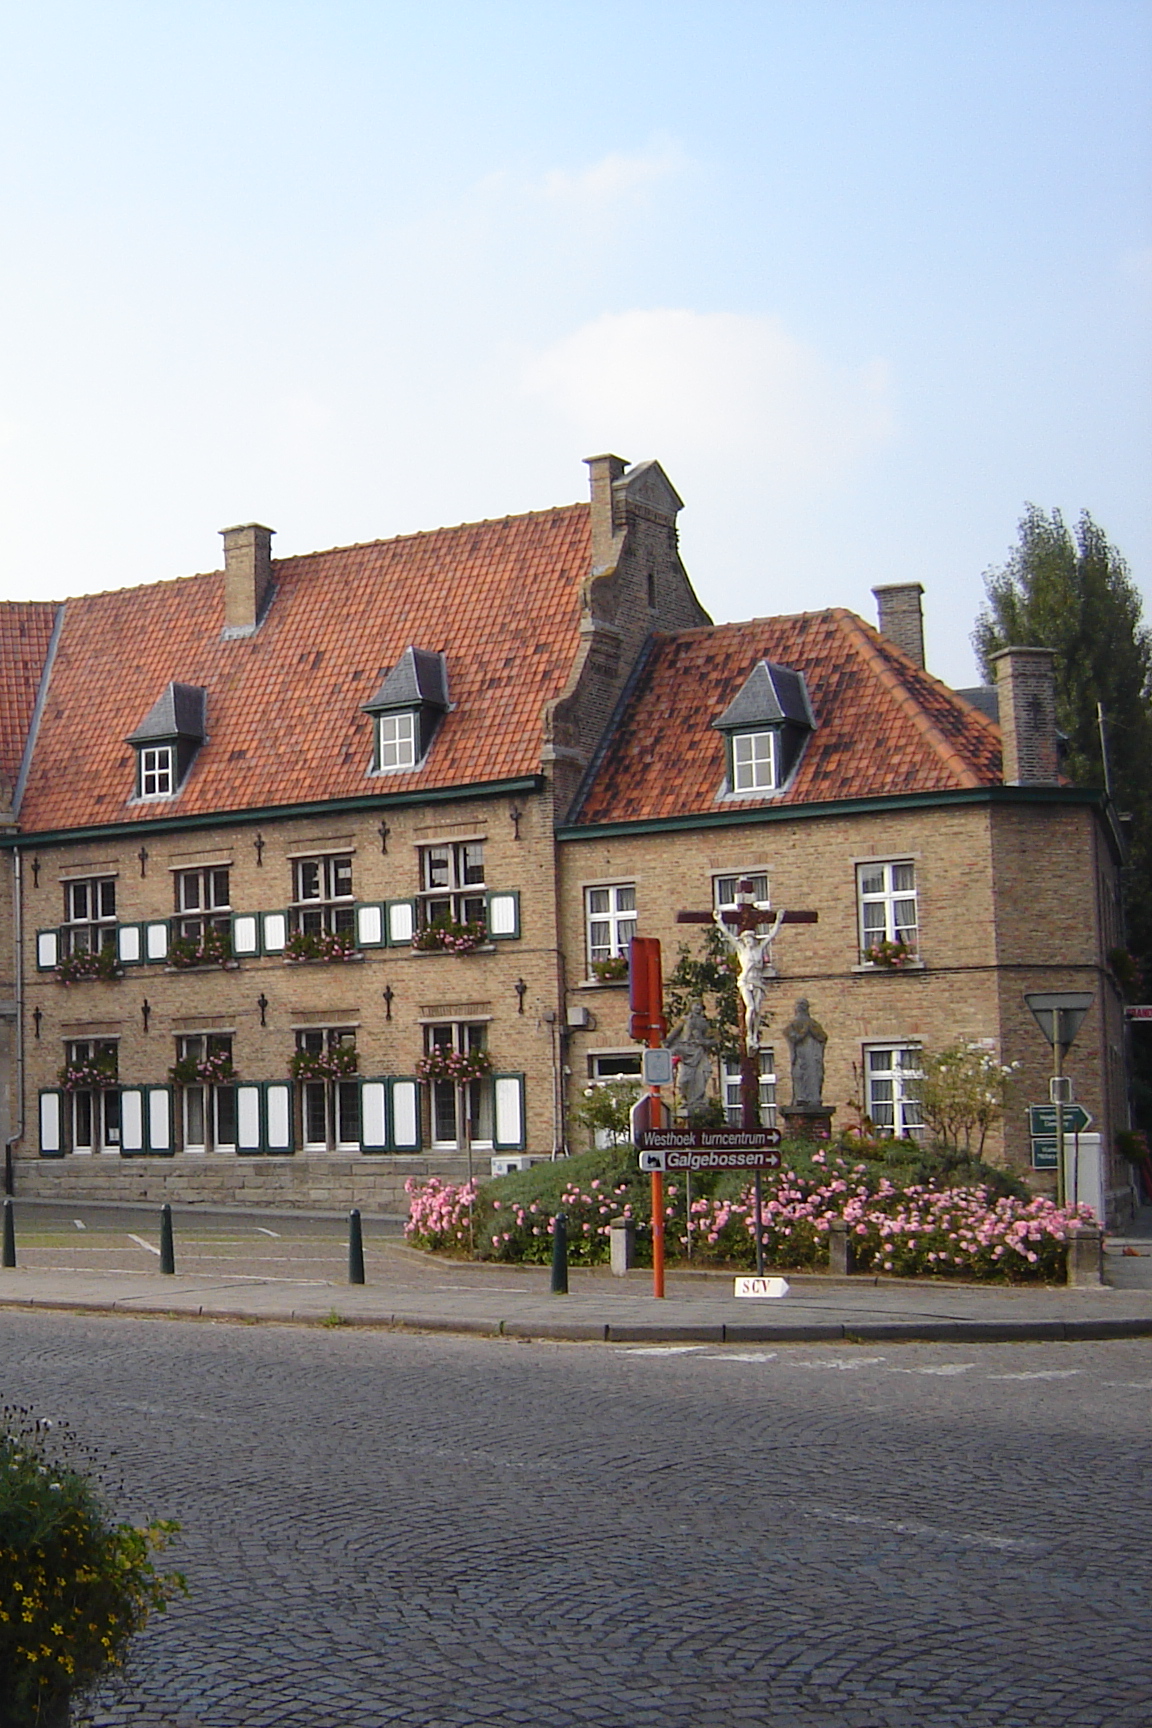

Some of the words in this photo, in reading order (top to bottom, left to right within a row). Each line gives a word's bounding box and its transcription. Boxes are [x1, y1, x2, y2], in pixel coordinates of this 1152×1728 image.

[644, 1132, 696, 1145] Westhoek
[701, 1132, 766, 1145] turncentrum
[667, 1152, 764, 1170] Galgebossen
[742, 1279, 770, 1293] SCV
